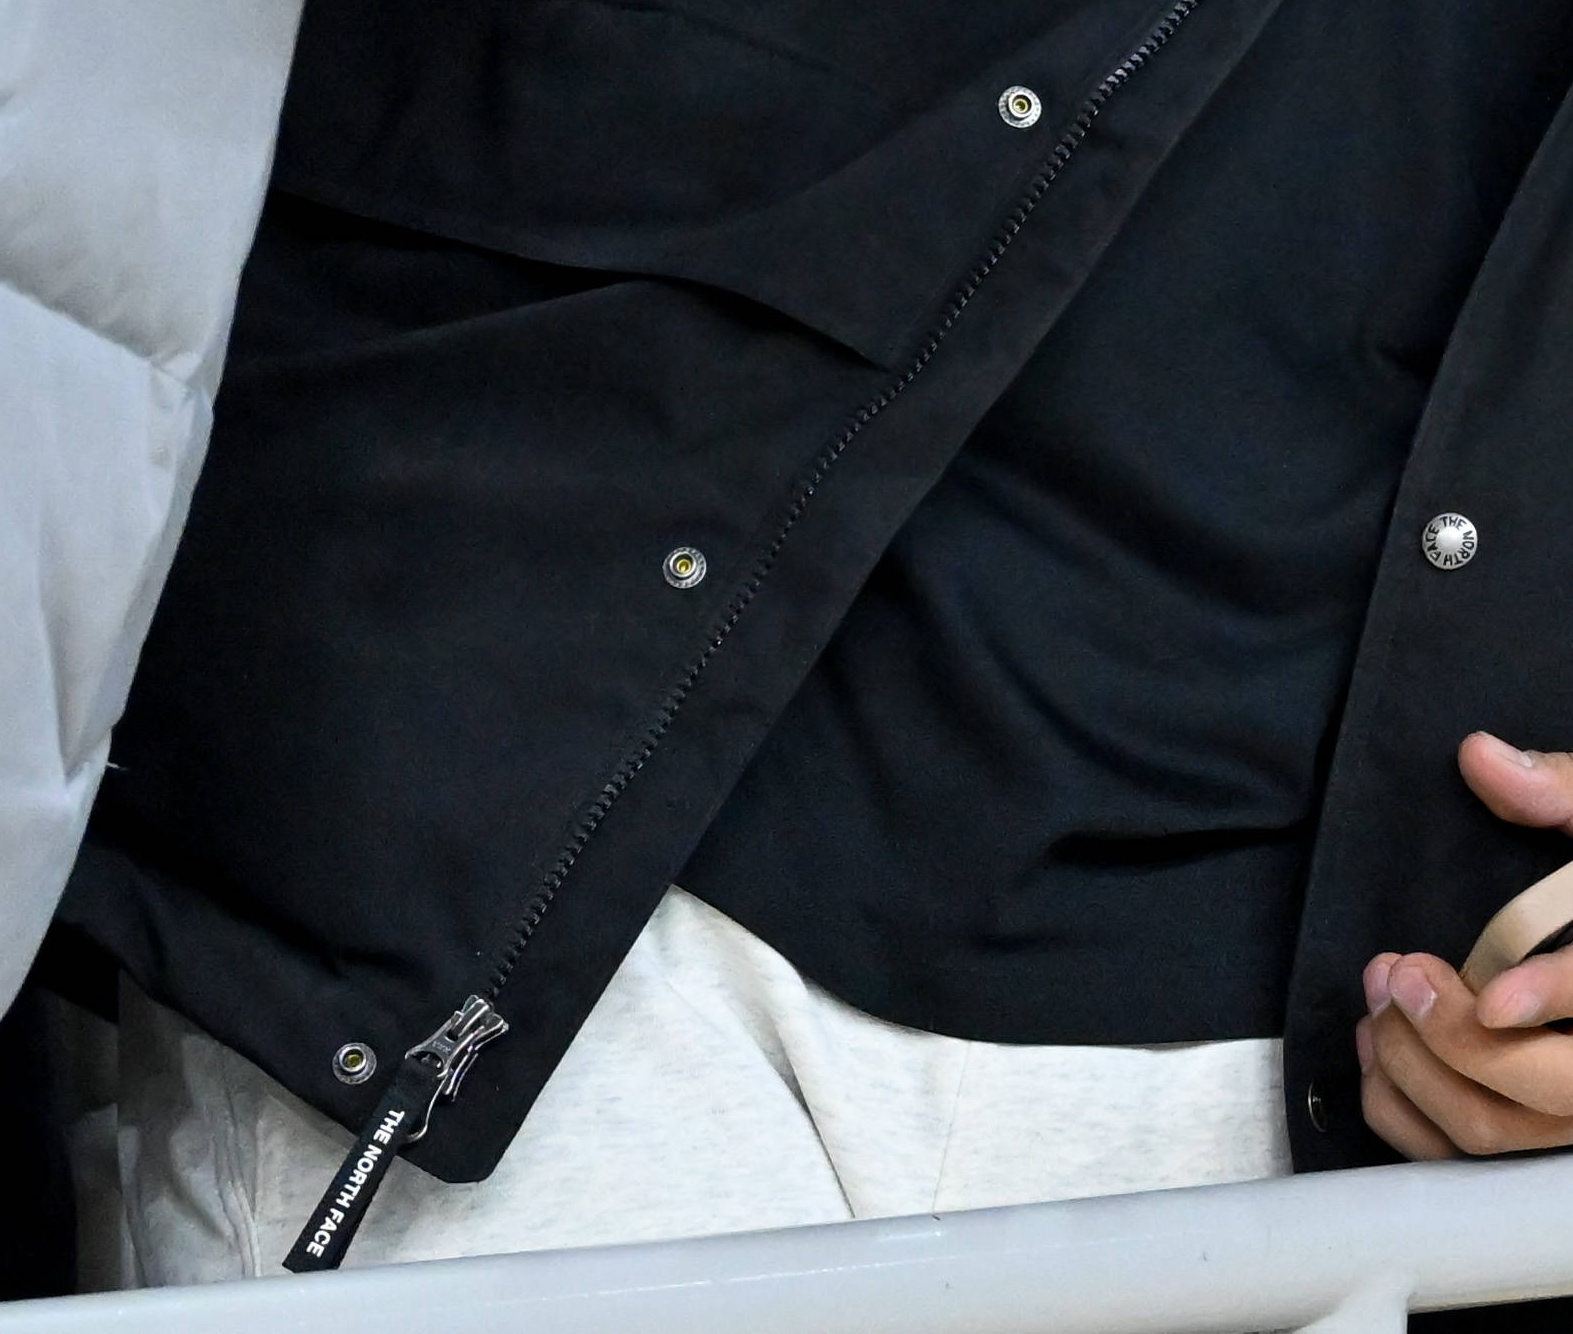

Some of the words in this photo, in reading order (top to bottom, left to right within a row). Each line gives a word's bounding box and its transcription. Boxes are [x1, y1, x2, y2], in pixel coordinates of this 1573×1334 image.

[1439, 516, 1467, 531] THE
[1425, 524, 1441, 562] FACE
[1442, 530, 1475, 566] NORTH
[372, 1109, 405, 1144] THE
[335, 1145, 383, 1208] NORTH
[306, 1208, 344, 1258] FACE
